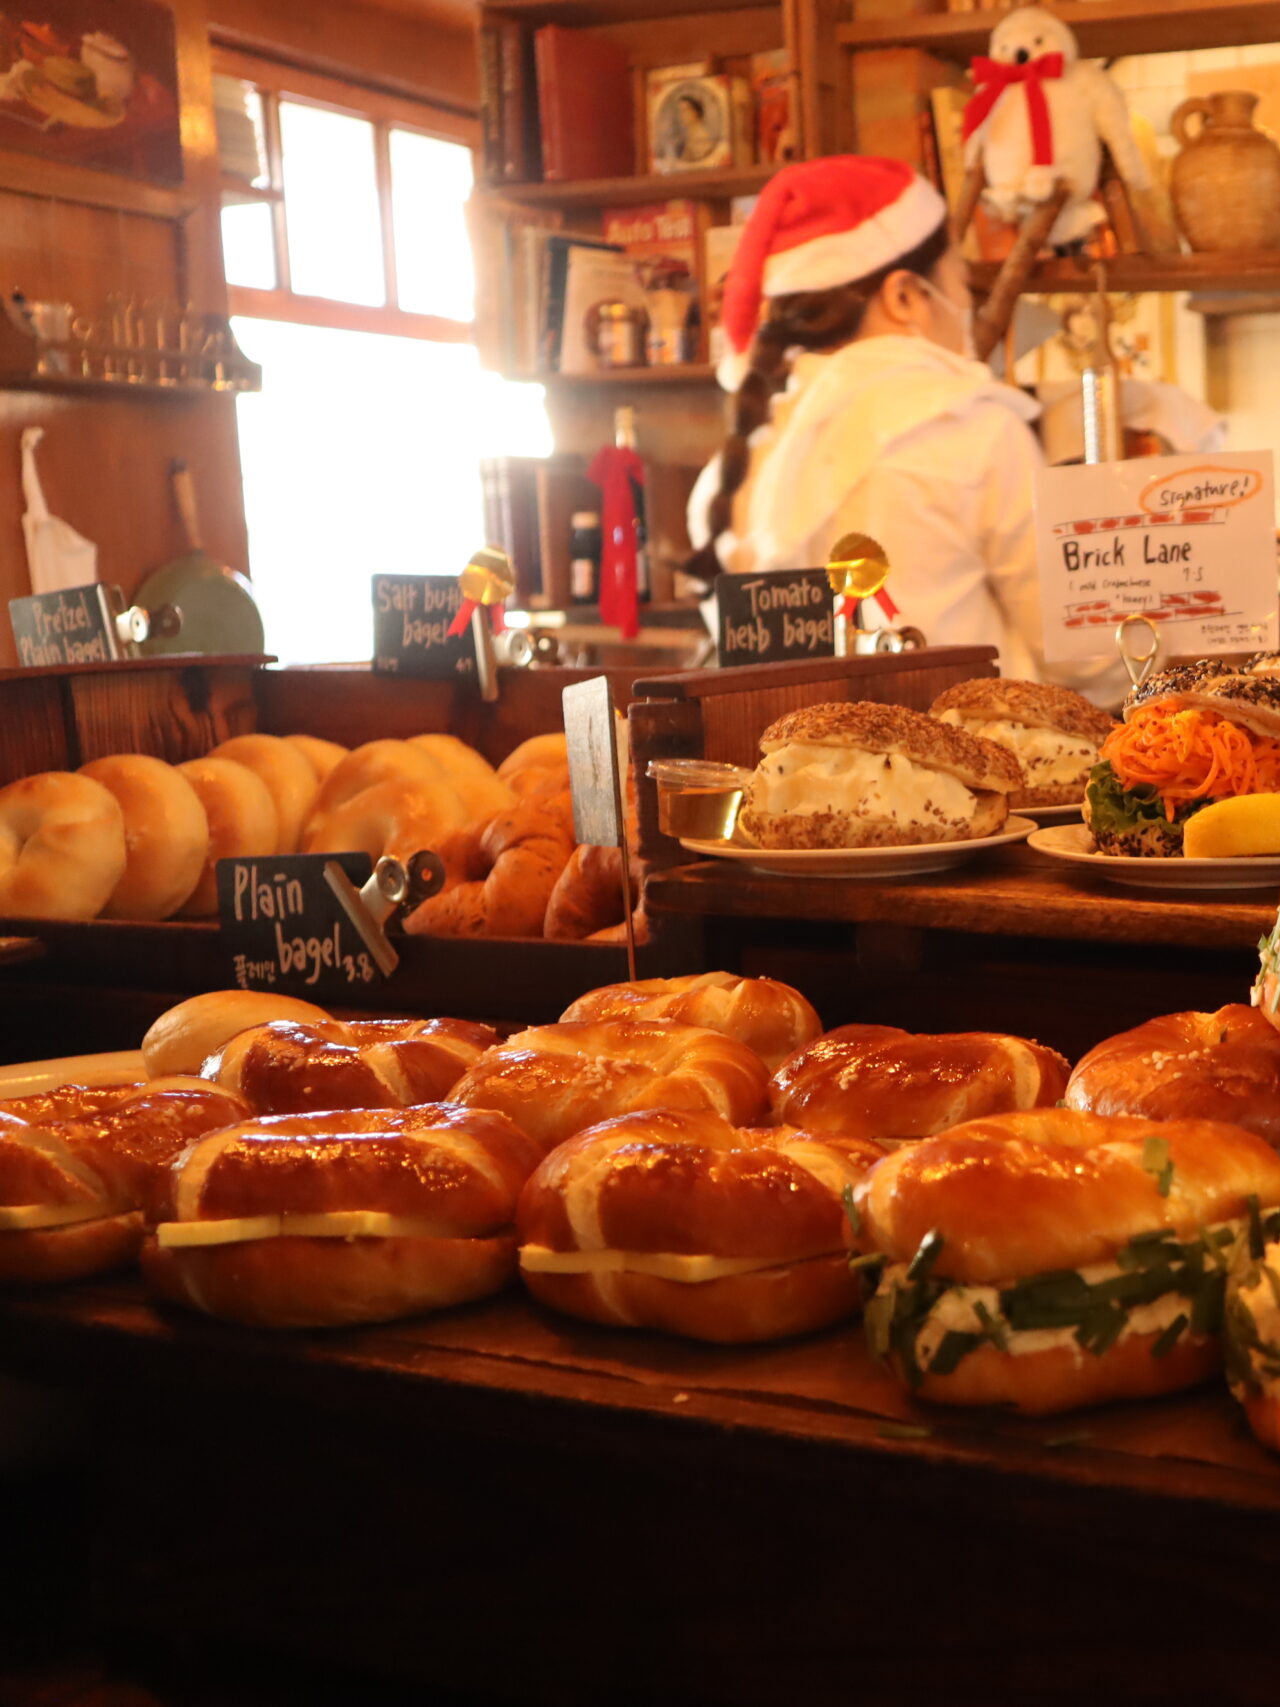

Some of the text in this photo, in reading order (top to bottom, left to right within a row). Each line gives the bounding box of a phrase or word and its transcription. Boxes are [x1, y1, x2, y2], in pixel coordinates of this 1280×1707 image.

[1062, 534, 1192, 572] Brick Lane
[32, 591, 92, 635] Pretzel
[376, 577, 418, 614] Salt
[741, 577, 823, 617] Tomato
[401, 613, 449, 649] bagel
[725, 610, 834, 654] herb bagel
[233, 864, 304, 922] Plain
[275, 921, 341, 985] bagel
[342, 952, 375, 983] 3.8
